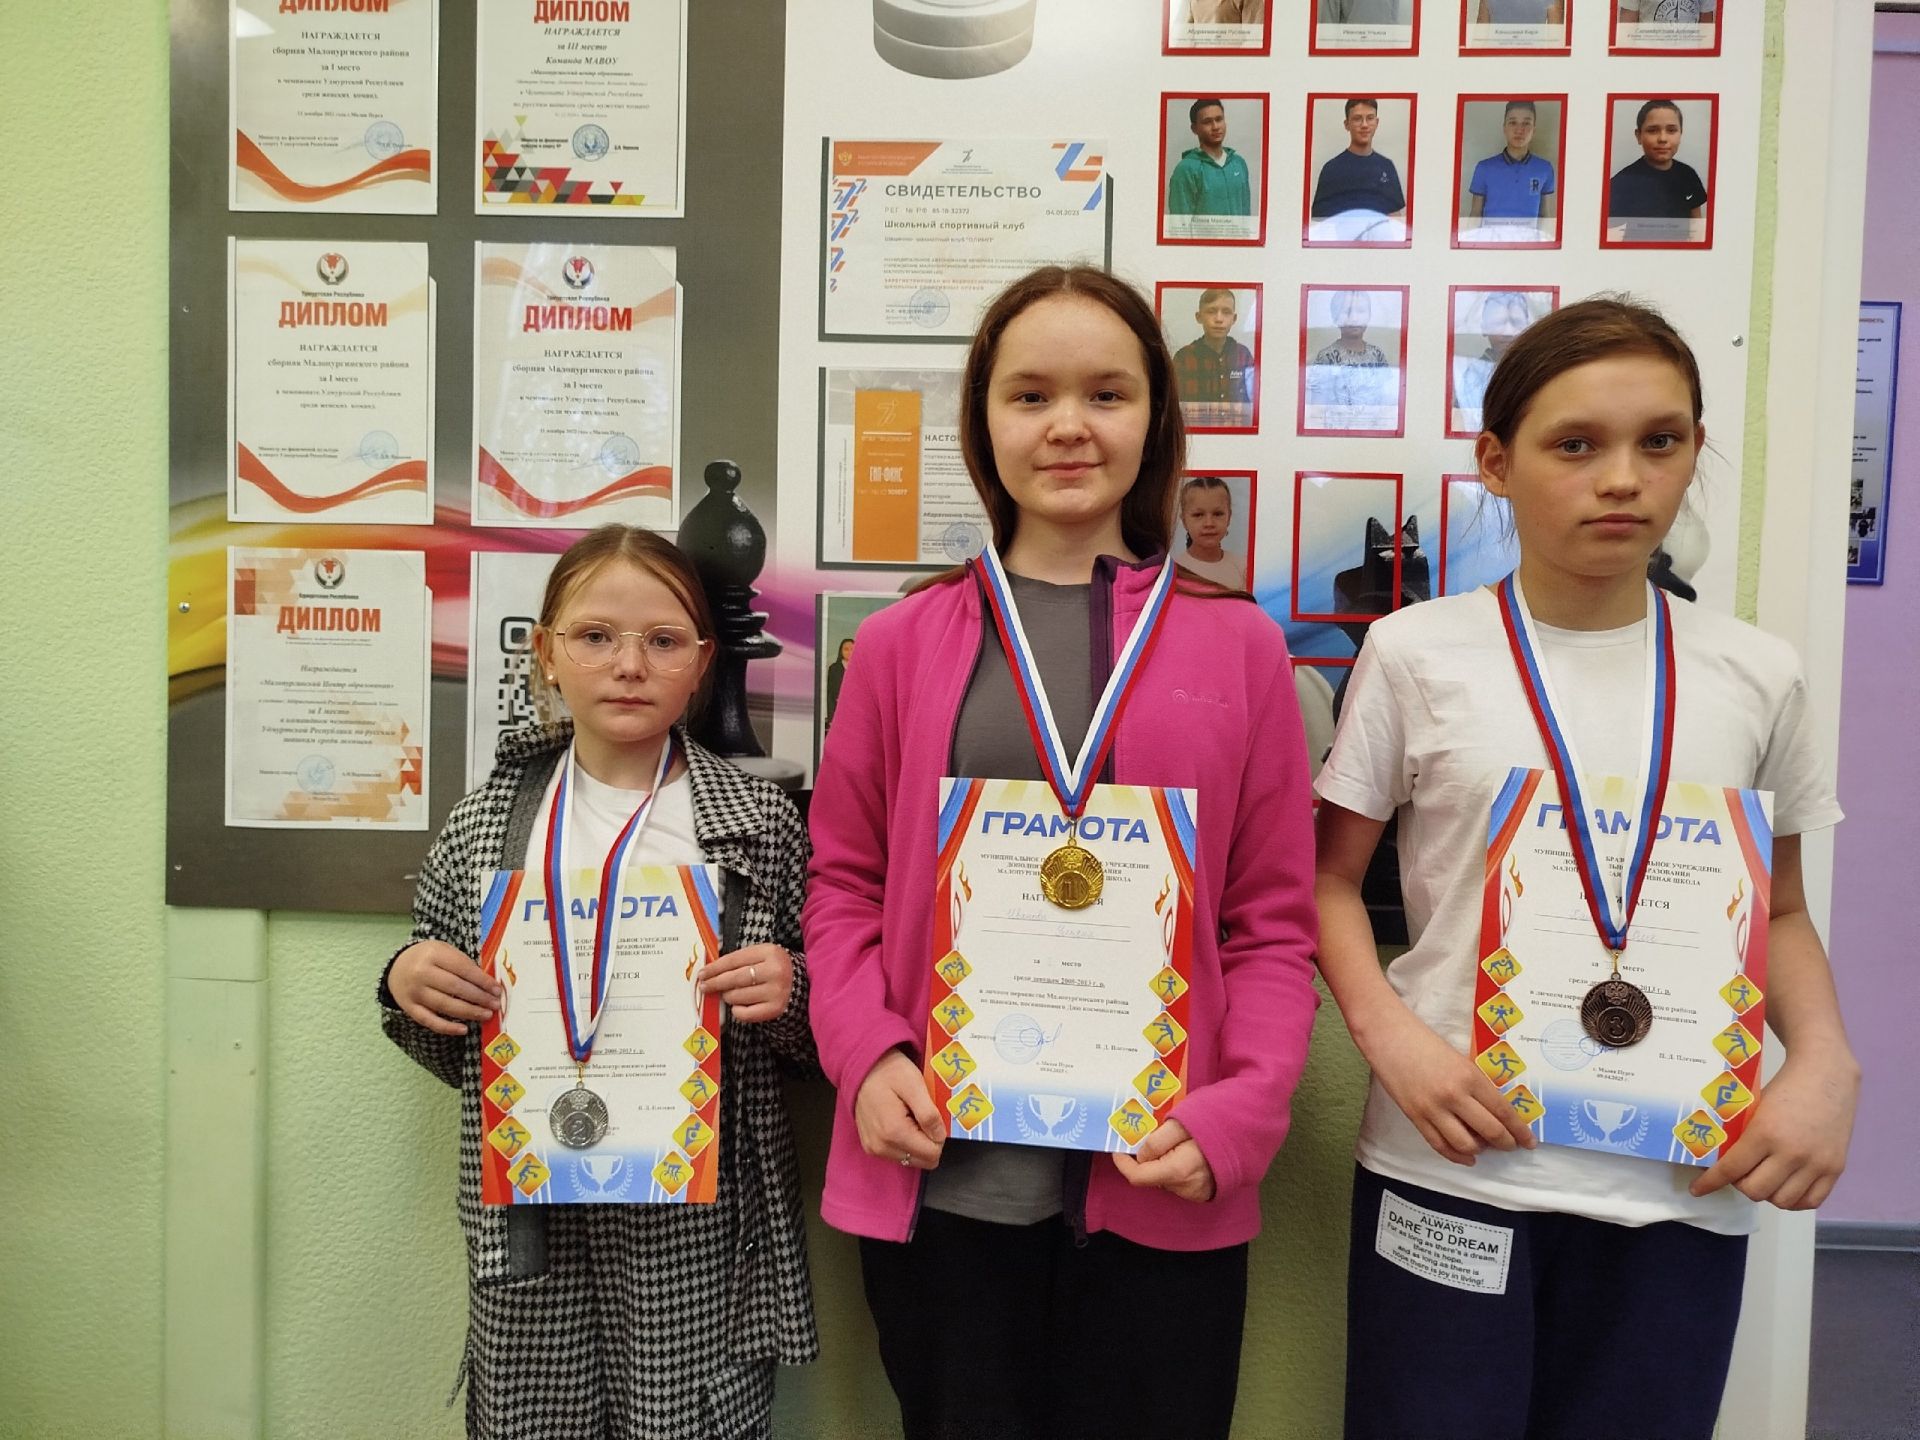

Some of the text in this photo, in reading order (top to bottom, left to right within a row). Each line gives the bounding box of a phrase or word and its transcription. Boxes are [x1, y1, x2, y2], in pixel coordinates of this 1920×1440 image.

[533, 0, 630, 24] ДИПЛОМ
[301, 31, 381, 40] НАГРАЖДАЕТСЯ
[544, 27, 621, 36] НАГРАЖДАЕТСЯ
[272, 47, 305, 57] сборная
[380, 49, 410, 58] района
[884, 184, 1042, 200] СВИДЕТЕЛЬСТВО
[884, 220, 1025, 232] Школьный спортивный клуб
[278, 301, 388, 329] ДИПЛОМ
[523, 305, 633, 333] ДИПЛОМ
[299, 344, 378, 352] НАГРАЖДАЕТСЯ
[543, 349, 623, 359] НАГРАЖДАЕТСЯ
[277, 606, 381, 634] ДИПЛОМ
[981, 810, 1150, 844] ГРАМОТА
[1673, 878, 1702, 887] ШКОЛА
[1061, 960, 1082, 968] место
[1608, 1016, 1626, 1039] 3
[571, 1119, 588, 1141] 2
[1388, 1210, 1499, 1255] DARE TO DREAM
[1420, 1215, 1465, 1235] ALWAYS
[1386, 1221, 1398, 1232] For
[1398, 1229, 1407, 1238] as
[1408, 1232, 1423, 1246] long
[1424, 1239, 1434, 1247] as
[1435, 1242, 1463, 1256] there's
[1397, 1245, 1411, 1256] and
[1422, 1253, 1439, 1267] long
[1440, 1260, 1449, 1268] as
[1450, 1261, 1471, 1274] there
[1472, 1268, 1480, 1276] is
[1413, 1244, 1433, 1257] there
[1433, 1251, 1441, 1259] is
[1392, 1249, 1409, 1263] hope
[1410, 1258, 1430, 1271] there
[1430, 1265, 1438, 1274] is
[1438, 1268, 1450, 1280] joy
[1451, 1272, 1460, 1280] in
